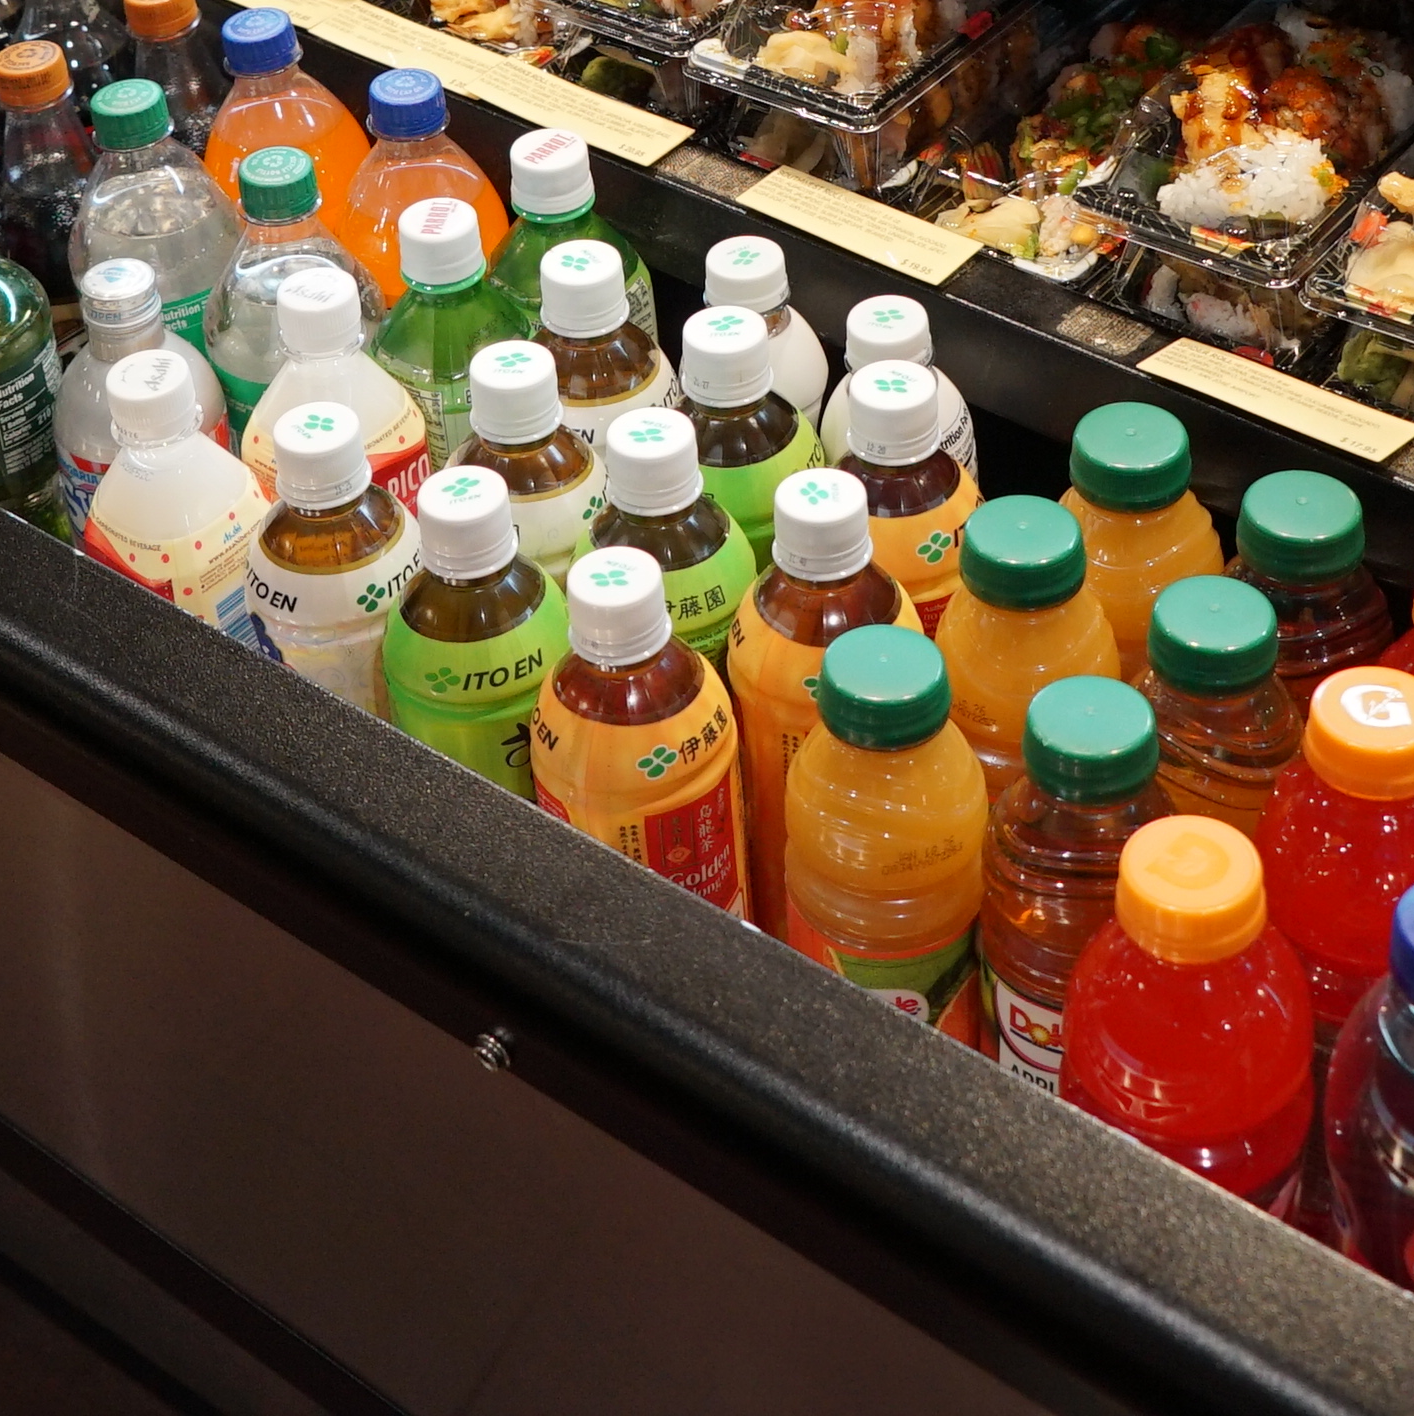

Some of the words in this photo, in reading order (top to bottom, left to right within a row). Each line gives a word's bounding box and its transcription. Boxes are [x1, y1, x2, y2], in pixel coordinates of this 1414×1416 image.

[523, 134, 572, 164] PARROT
[421, 201, 451, 236] PARROT
[284, 284, 335, 304] Asahi
[165, 320, 188, 331] acts
[144, 357, 174, 392] Asahi
[37, 407, 52, 426] 210
[940, 417, 963, 451] trition
[247, 568, 270, 600] ITO
[269, 590, 298, 613] EN
[732, 618, 746, 649] EN
[462, 666, 510, 692] ITO
[514, 647, 544, 681] EN
[1340, 684, 1412, 728] G
[537, 725, 560, 752] EN
[677, 704, 729, 766] 伊藤園
